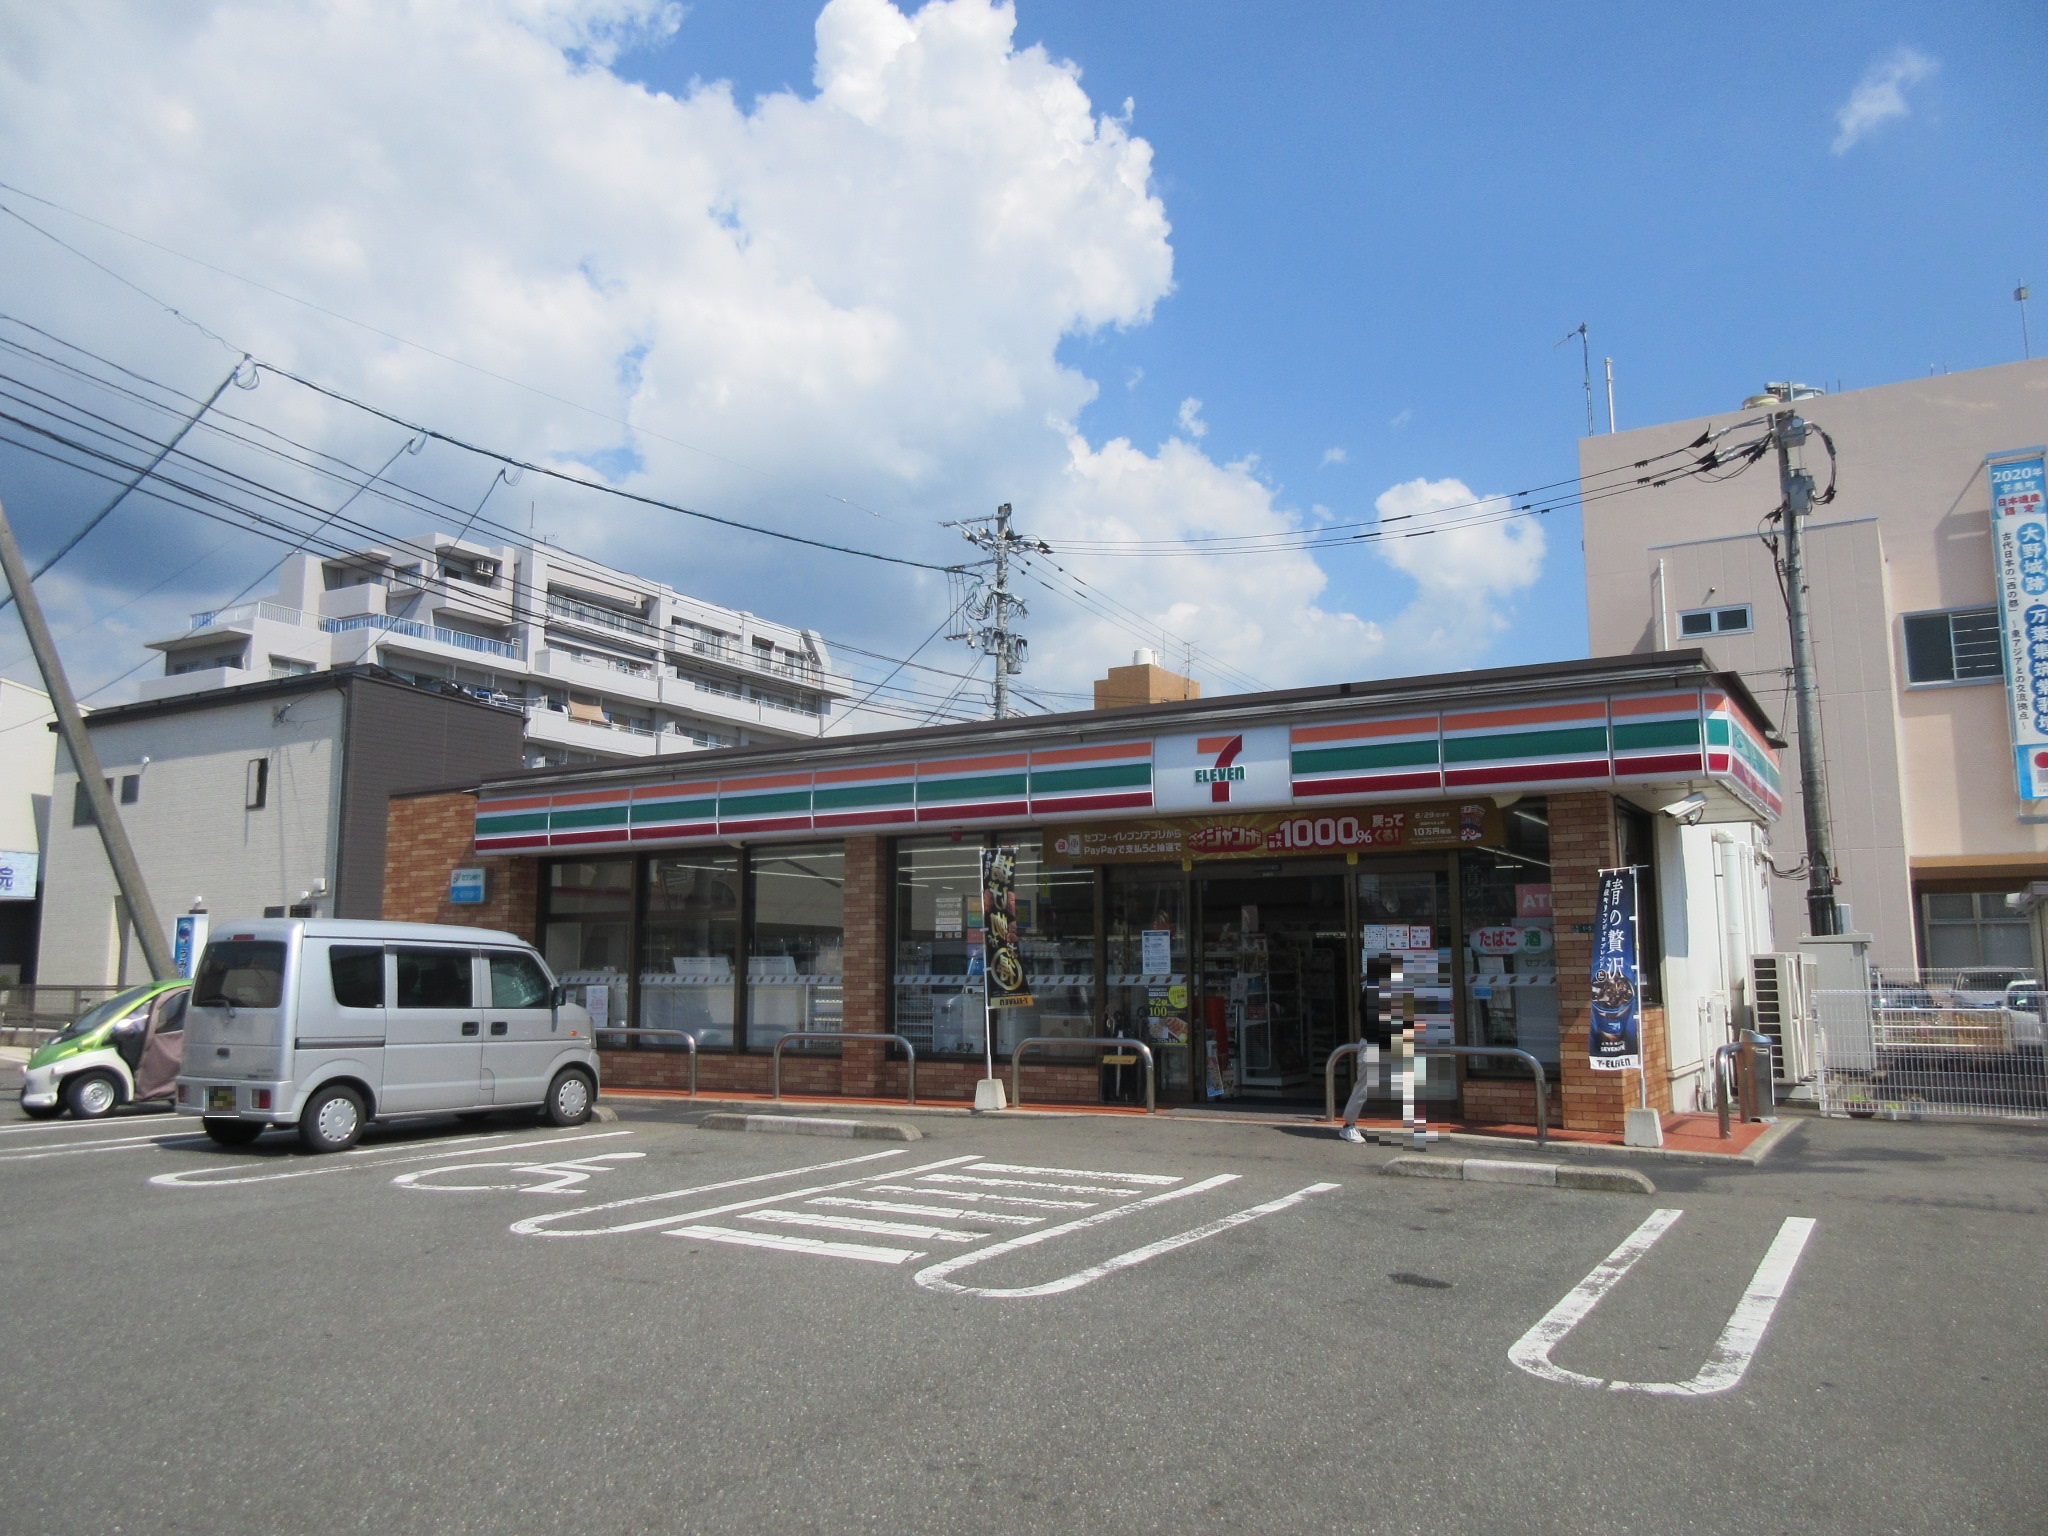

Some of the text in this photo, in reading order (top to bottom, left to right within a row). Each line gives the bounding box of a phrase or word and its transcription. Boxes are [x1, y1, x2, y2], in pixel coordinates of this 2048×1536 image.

[1993, 467, 2042, 483] 2020年
[1197, 734, 1243, 803] 7
[1371, 814, 1405, 828] 戻って
[1279, 816, 1373, 848] 1000%
[1606, 878, 1625, 979] 青の贅沢
[1480, 930, 1517, 947] たばこ
[1524, 930, 1541, 947] 酒
